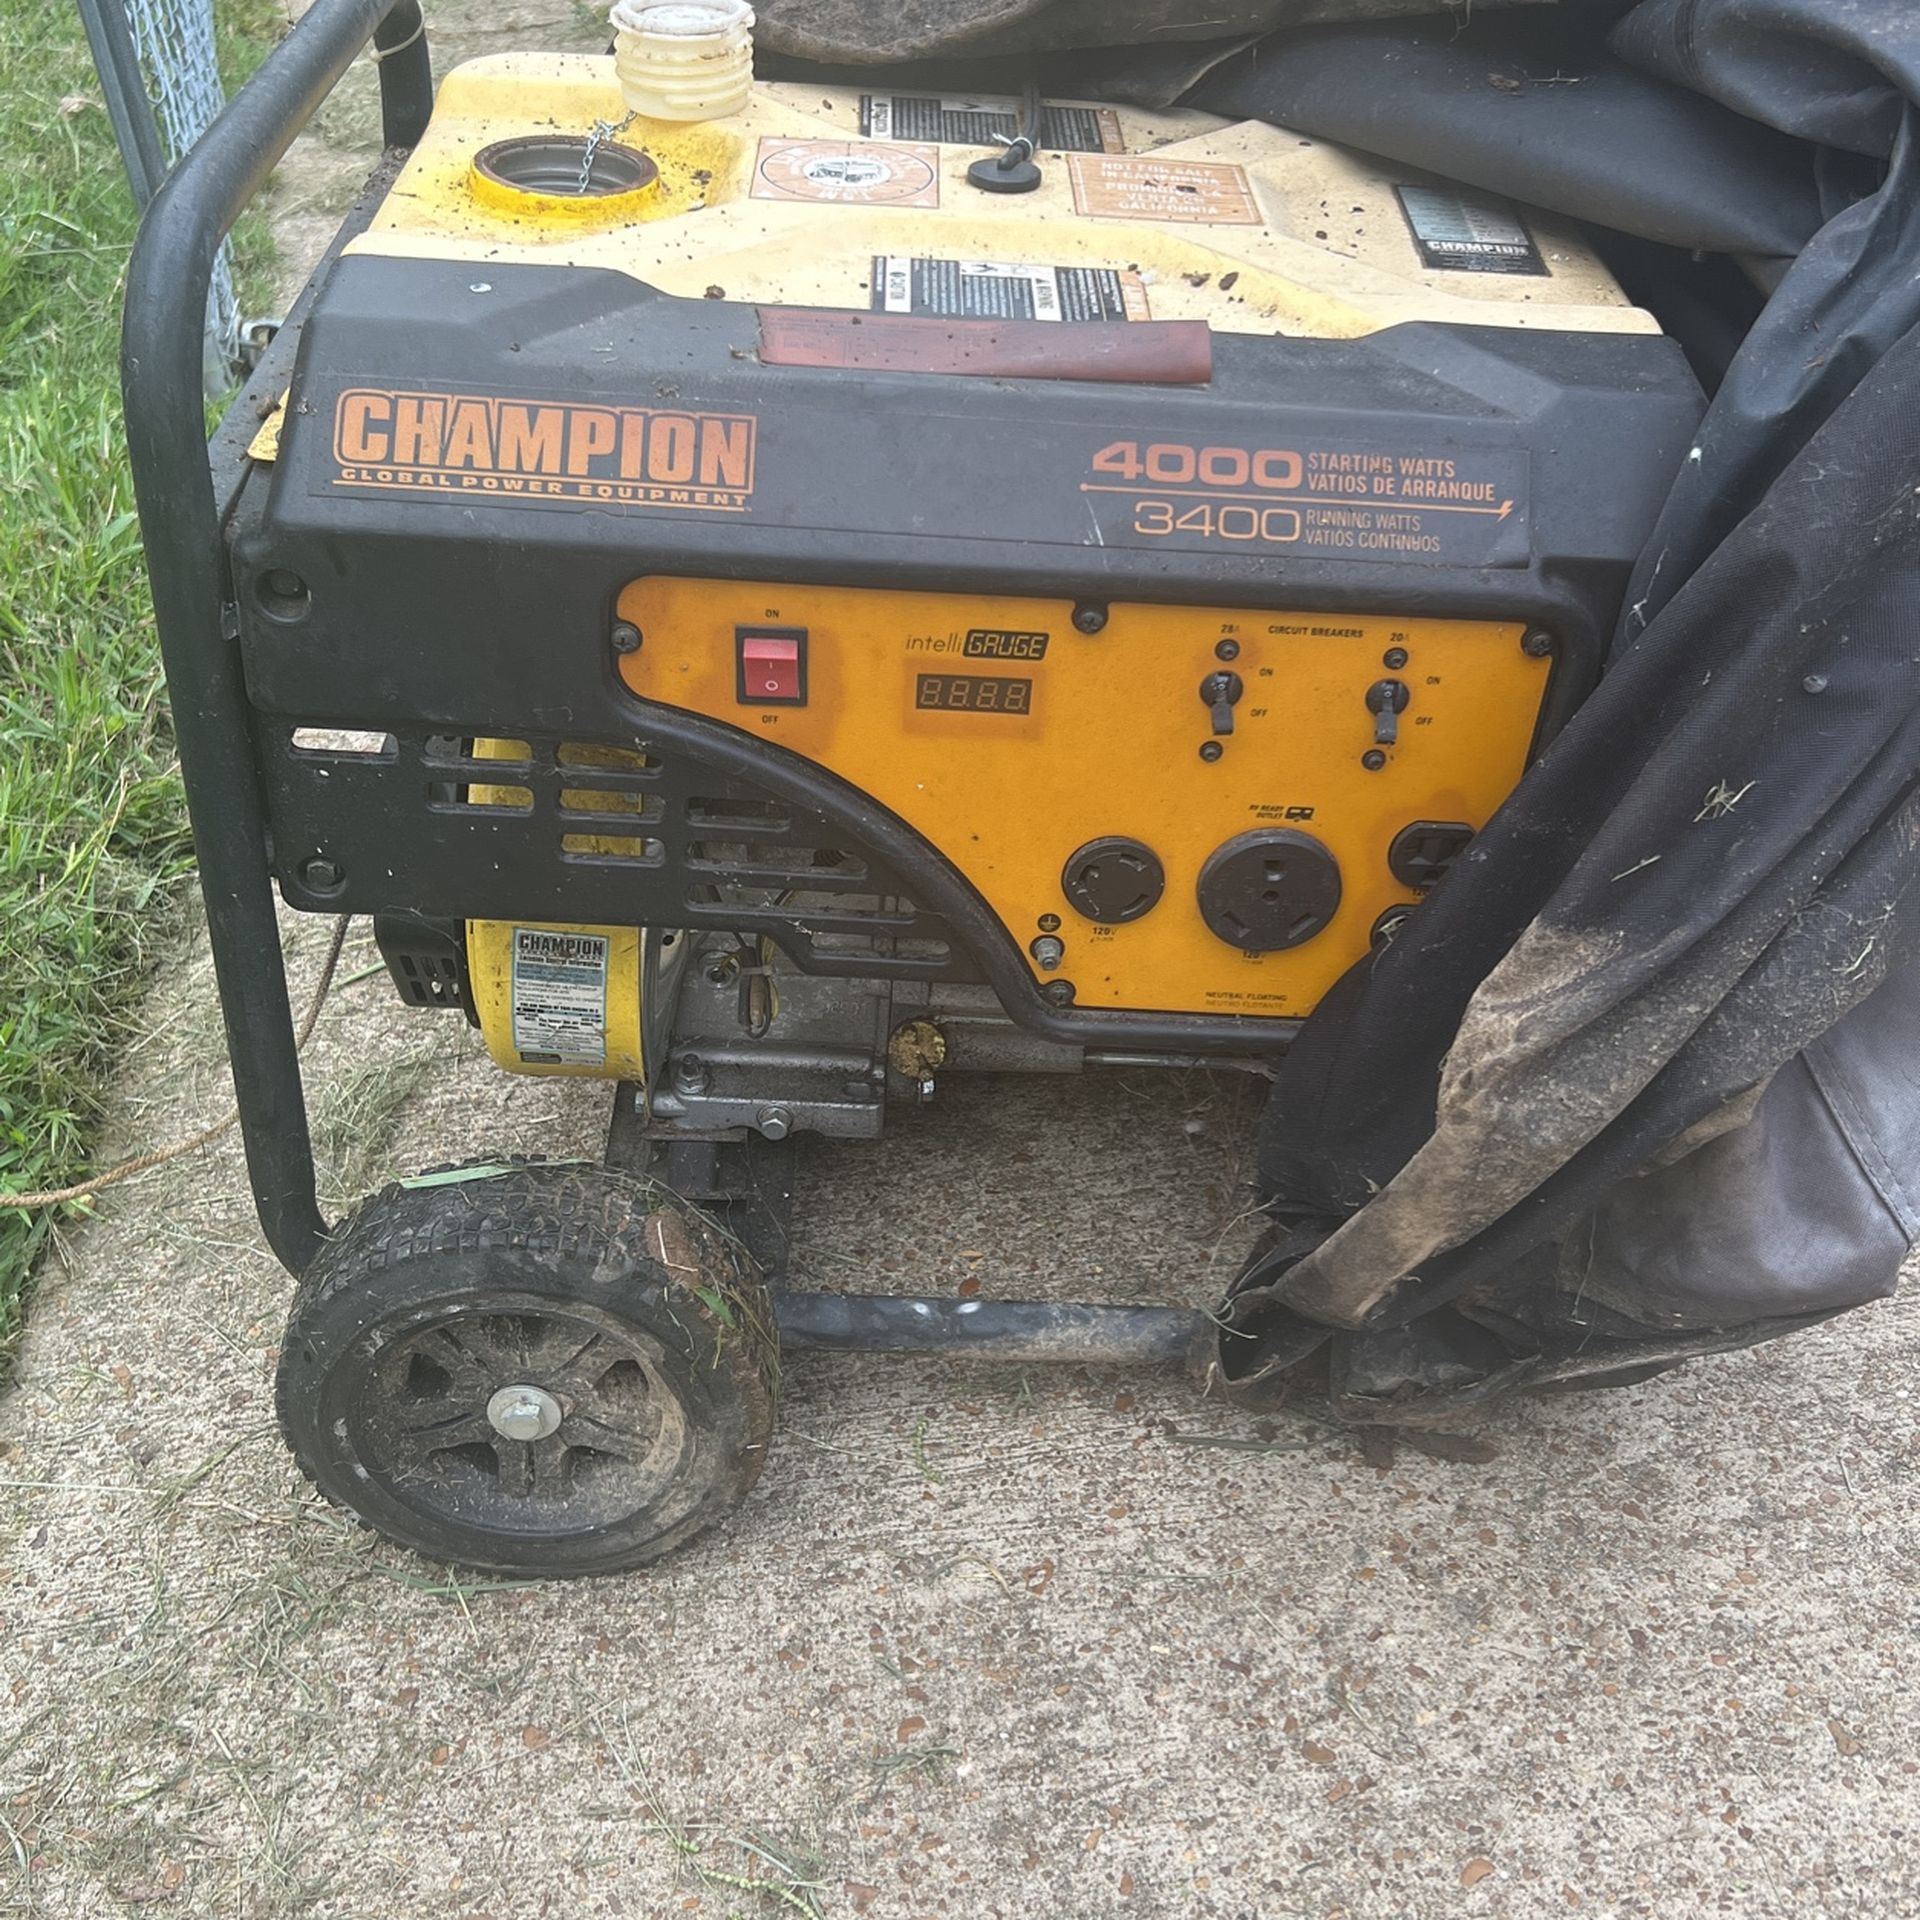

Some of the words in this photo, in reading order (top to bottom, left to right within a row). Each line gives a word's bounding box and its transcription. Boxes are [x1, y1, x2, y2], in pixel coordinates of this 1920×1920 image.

[340, 393, 747, 487] CHAMPION
[1092, 442, 1303, 489] 4000
[1307, 452, 1393, 475] STARTING
[1399, 457, 1456, 478] WATTS
[341, 468, 450, 486] GLOBAL
[462, 475, 563, 494] POWER
[578, 484, 746, 506] EQUIPMENT
[1307, 473, 1368, 494] VATIOS
[1373, 477, 1396, 496] DE
[1401, 479, 1496, 501] ARRANQUE
[1133, 501, 1300, 542] 3400
[1306, 508, 1372, 529] RUNNING
[1376, 515, 1422, 532] WATTS
[1305, 529, 1354, 548] VATIOS
[765, 609, 780, 618] ON
[1268, 625, 1308, 636] CIRCUIT
[1311, 627, 1364, 638] BREAKERS
[1259, 667, 1274, 677] ON
[1426, 676, 1441, 686] ON
[761, 715, 779, 725] OFF
[1250, 708, 1268, 718] OFF
[1415, 717, 1433, 726] OFF
[519, 933, 605, 956] CHAMPION
[1247, 993, 1287, 1001] FLOATING
